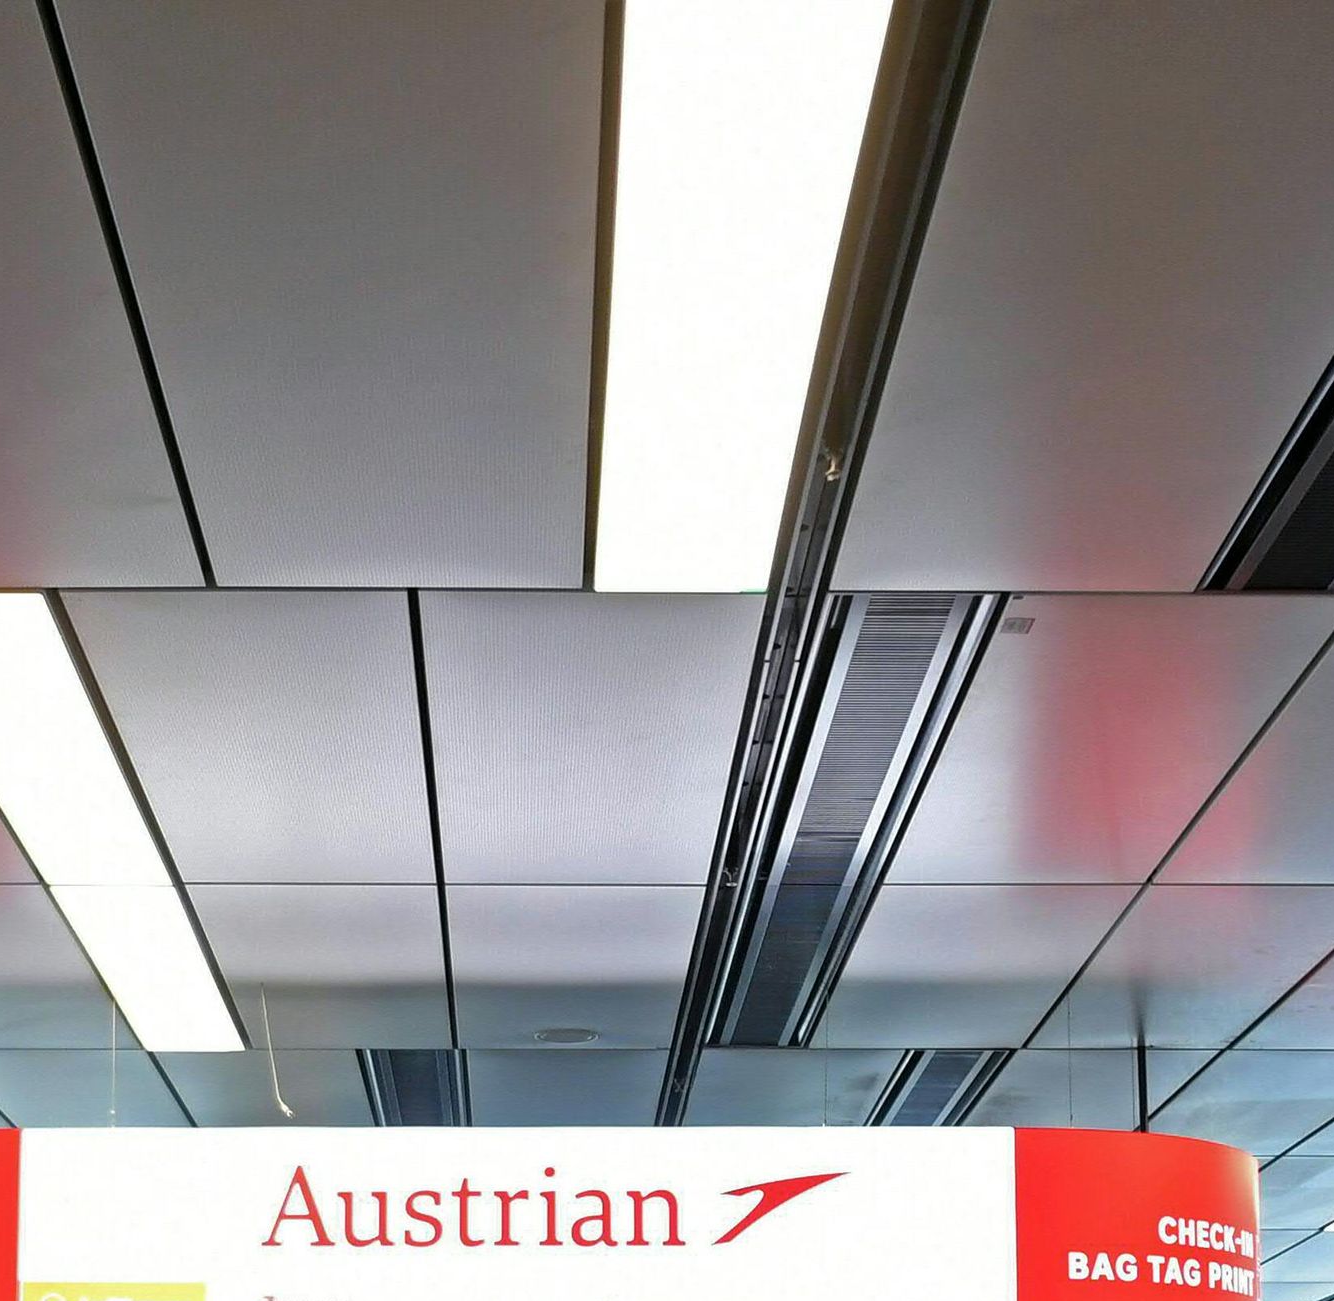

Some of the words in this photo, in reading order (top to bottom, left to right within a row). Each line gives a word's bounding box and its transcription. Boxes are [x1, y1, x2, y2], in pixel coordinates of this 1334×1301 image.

[261, 1165, 686, 1247] Austrian
[1157, 1216, 1254, 1258] CHECK-IN
[1067, 1251, 1138, 1282] BAG
[1146, 1254, 1201, 1287] TAG
[1208, 1261, 1255, 1297] PRINT
